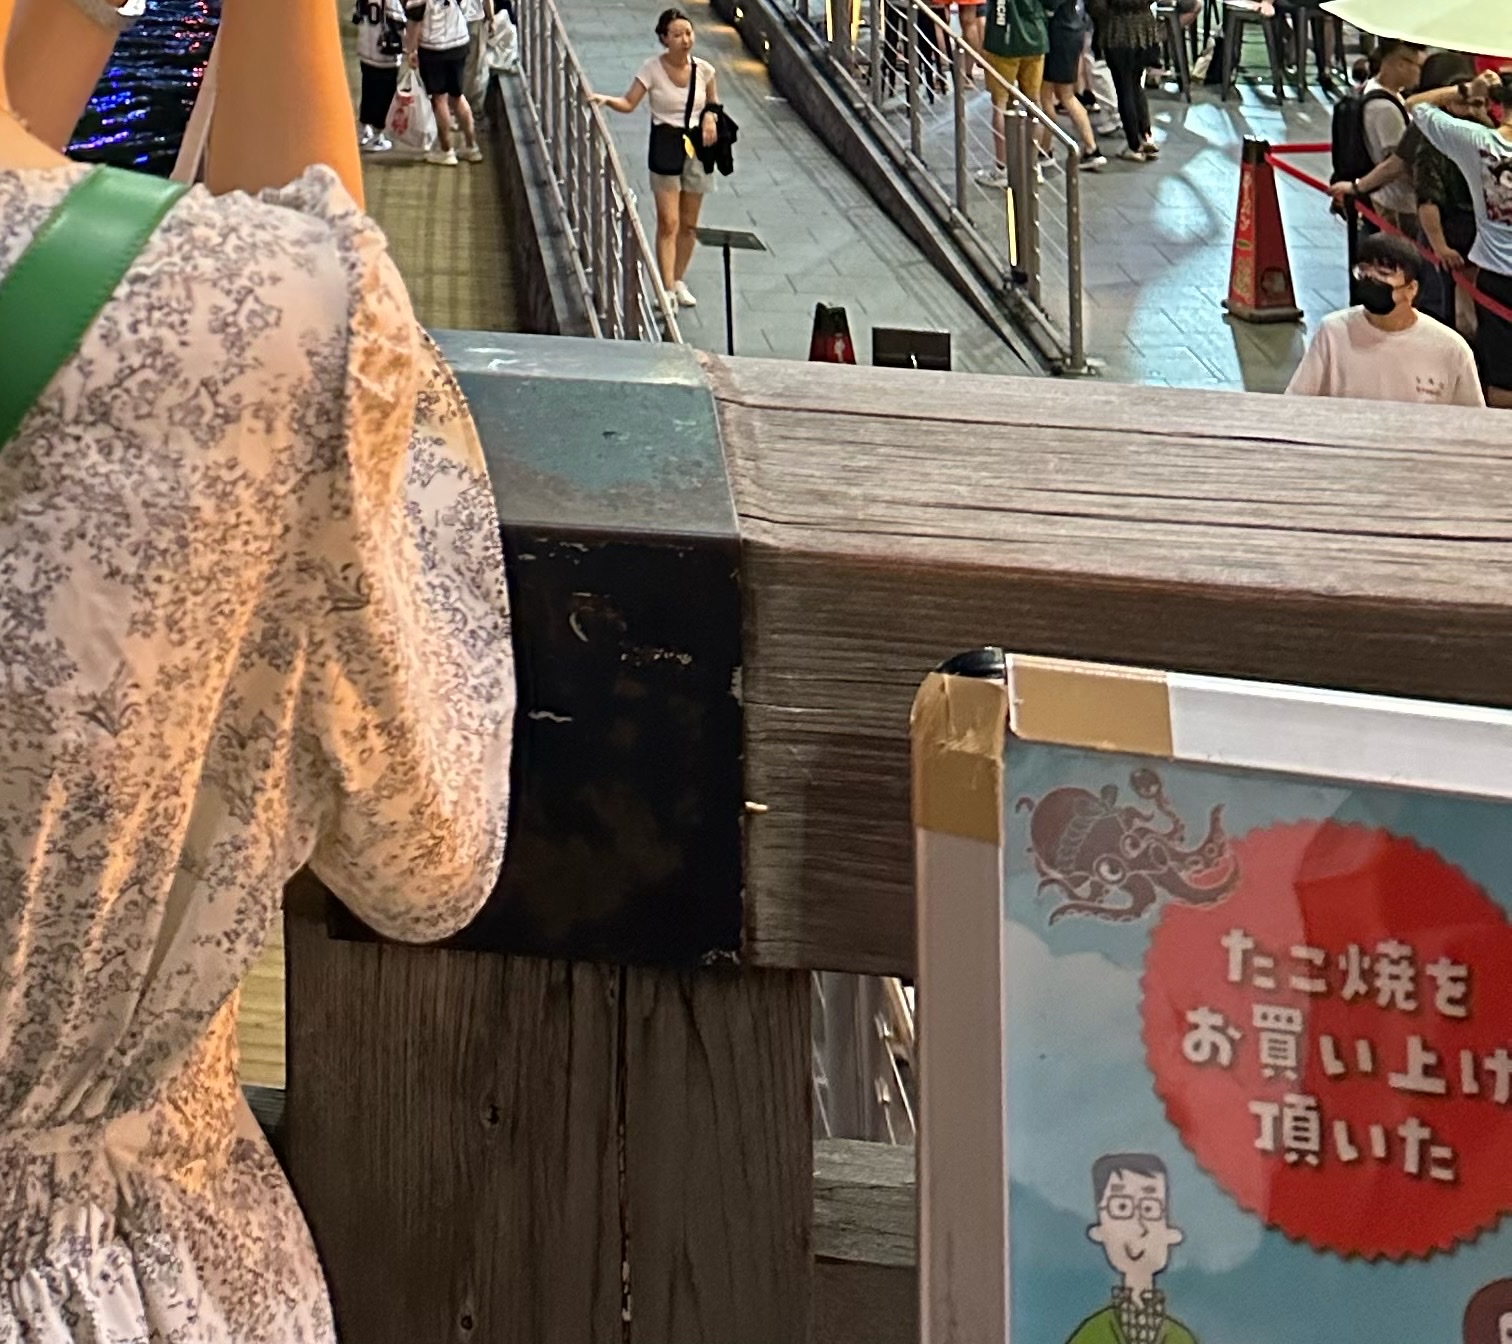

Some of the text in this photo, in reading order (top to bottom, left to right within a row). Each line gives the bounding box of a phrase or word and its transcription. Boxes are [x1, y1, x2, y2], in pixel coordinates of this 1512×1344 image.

[1220, 928, 1469, 1018] たこ焼を
[1248, 1093, 1456, 1181] 頂いた
